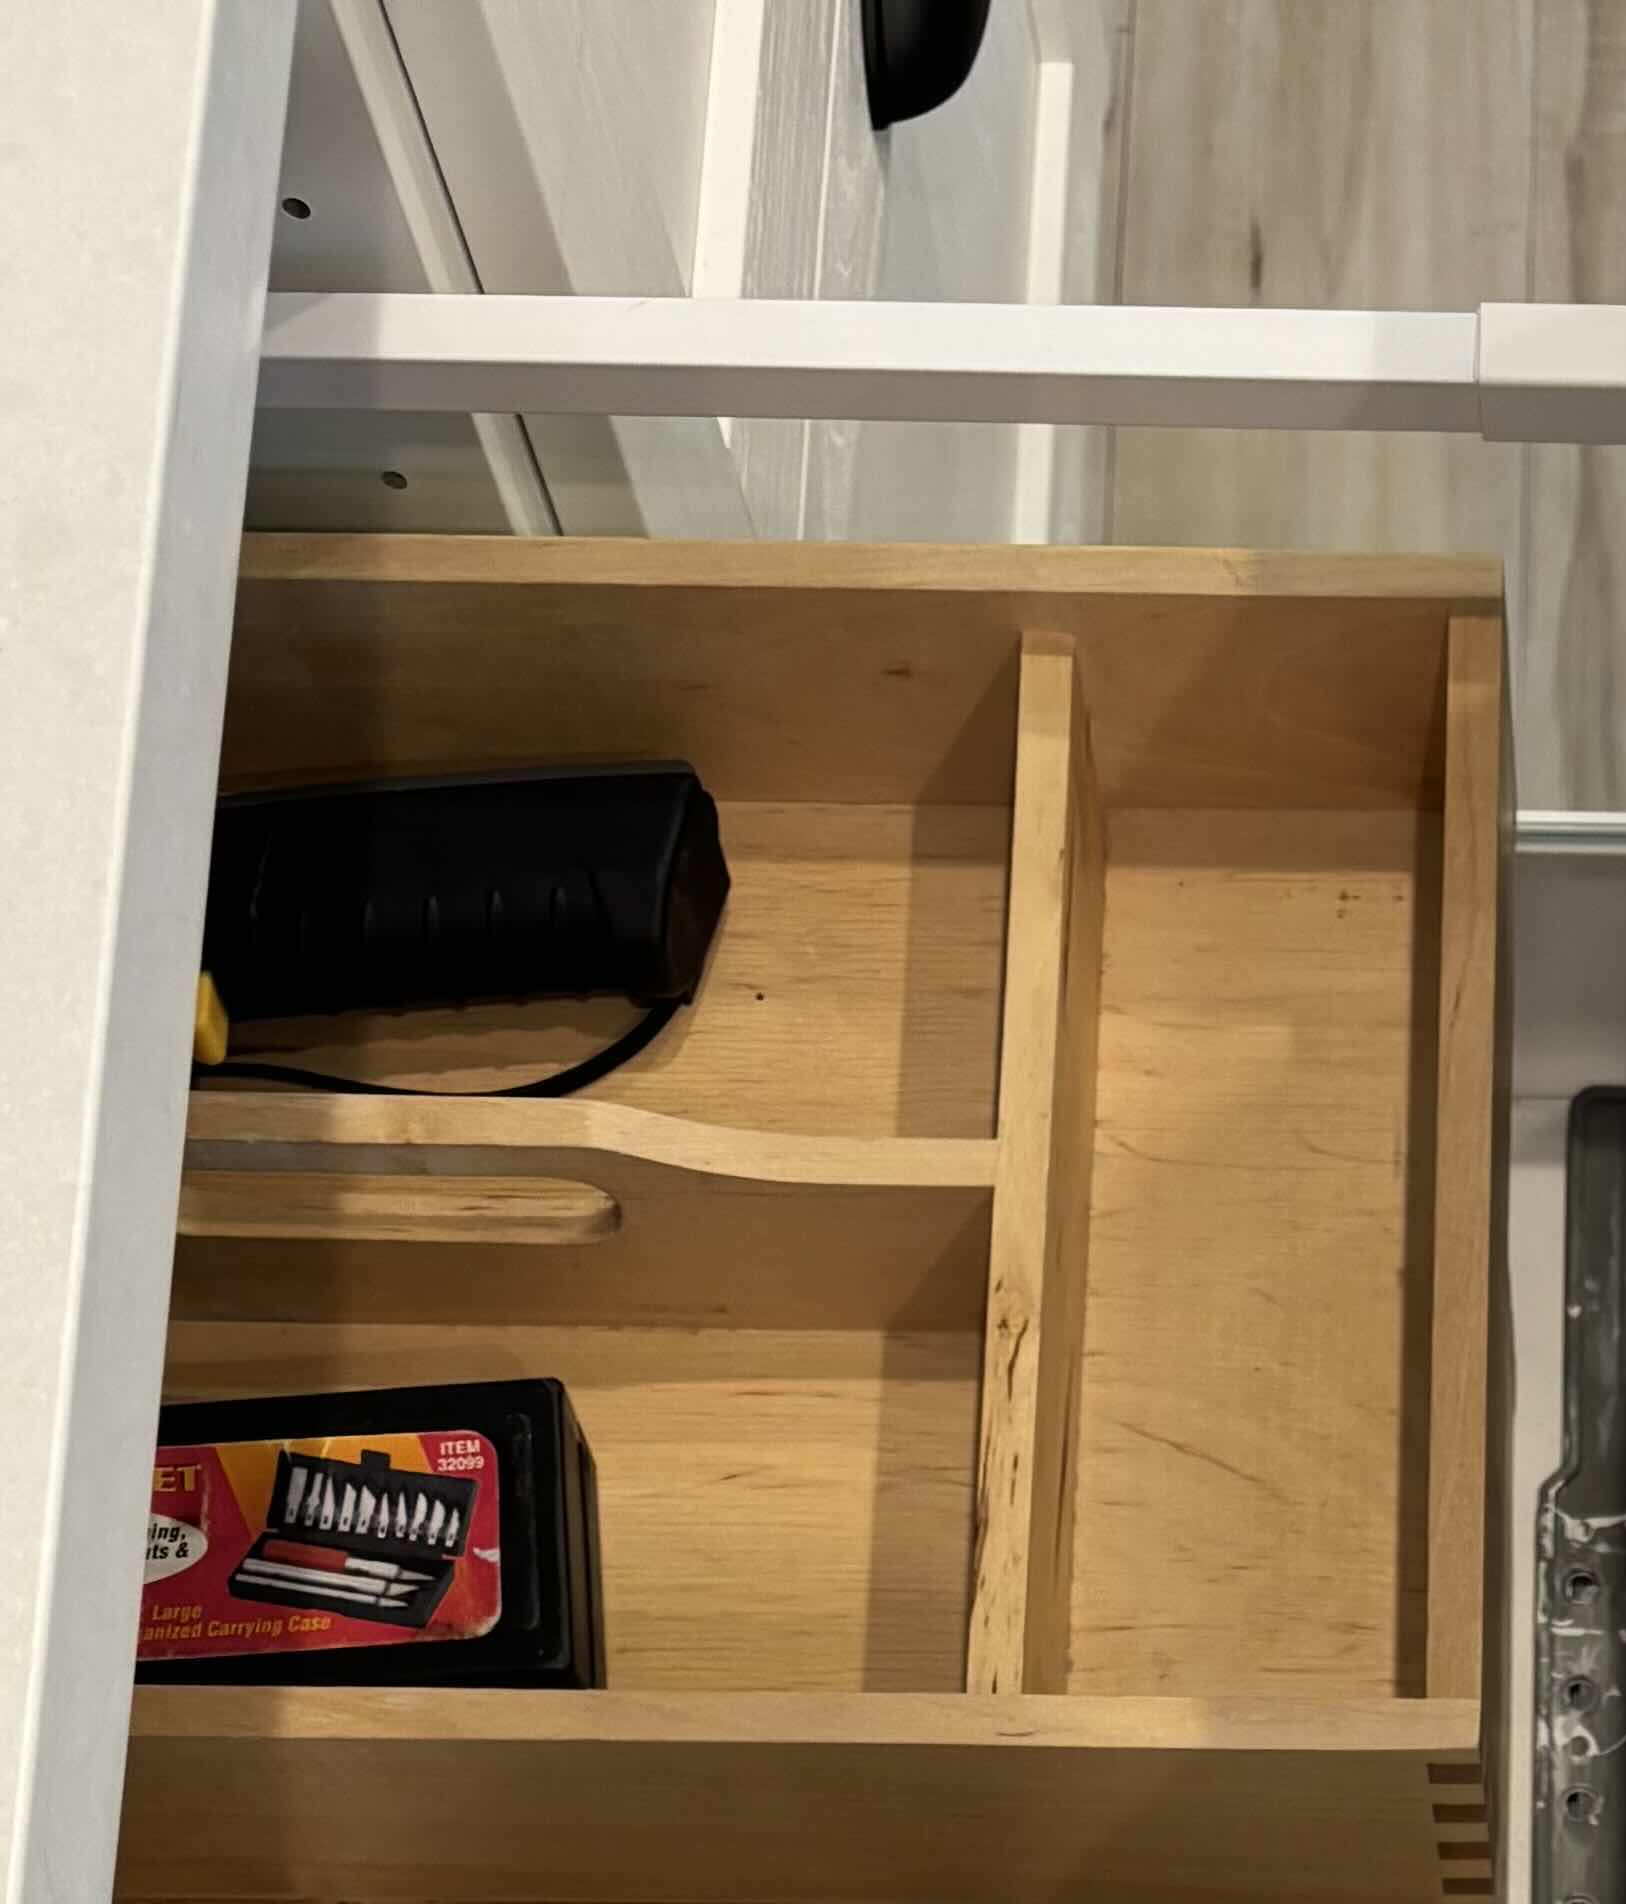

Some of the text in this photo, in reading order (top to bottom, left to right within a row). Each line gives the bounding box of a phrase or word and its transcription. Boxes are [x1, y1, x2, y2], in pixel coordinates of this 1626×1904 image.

[440, 1440, 481, 1456] ITEM
[437, 1456, 485, 1471] 32099
[148, 1523, 187, 1542] ing,
[176, 1542, 189, 1559] &
[153, 1604, 202, 1622] Large
[144, 1615, 332, 1641] anized Carrying Case
